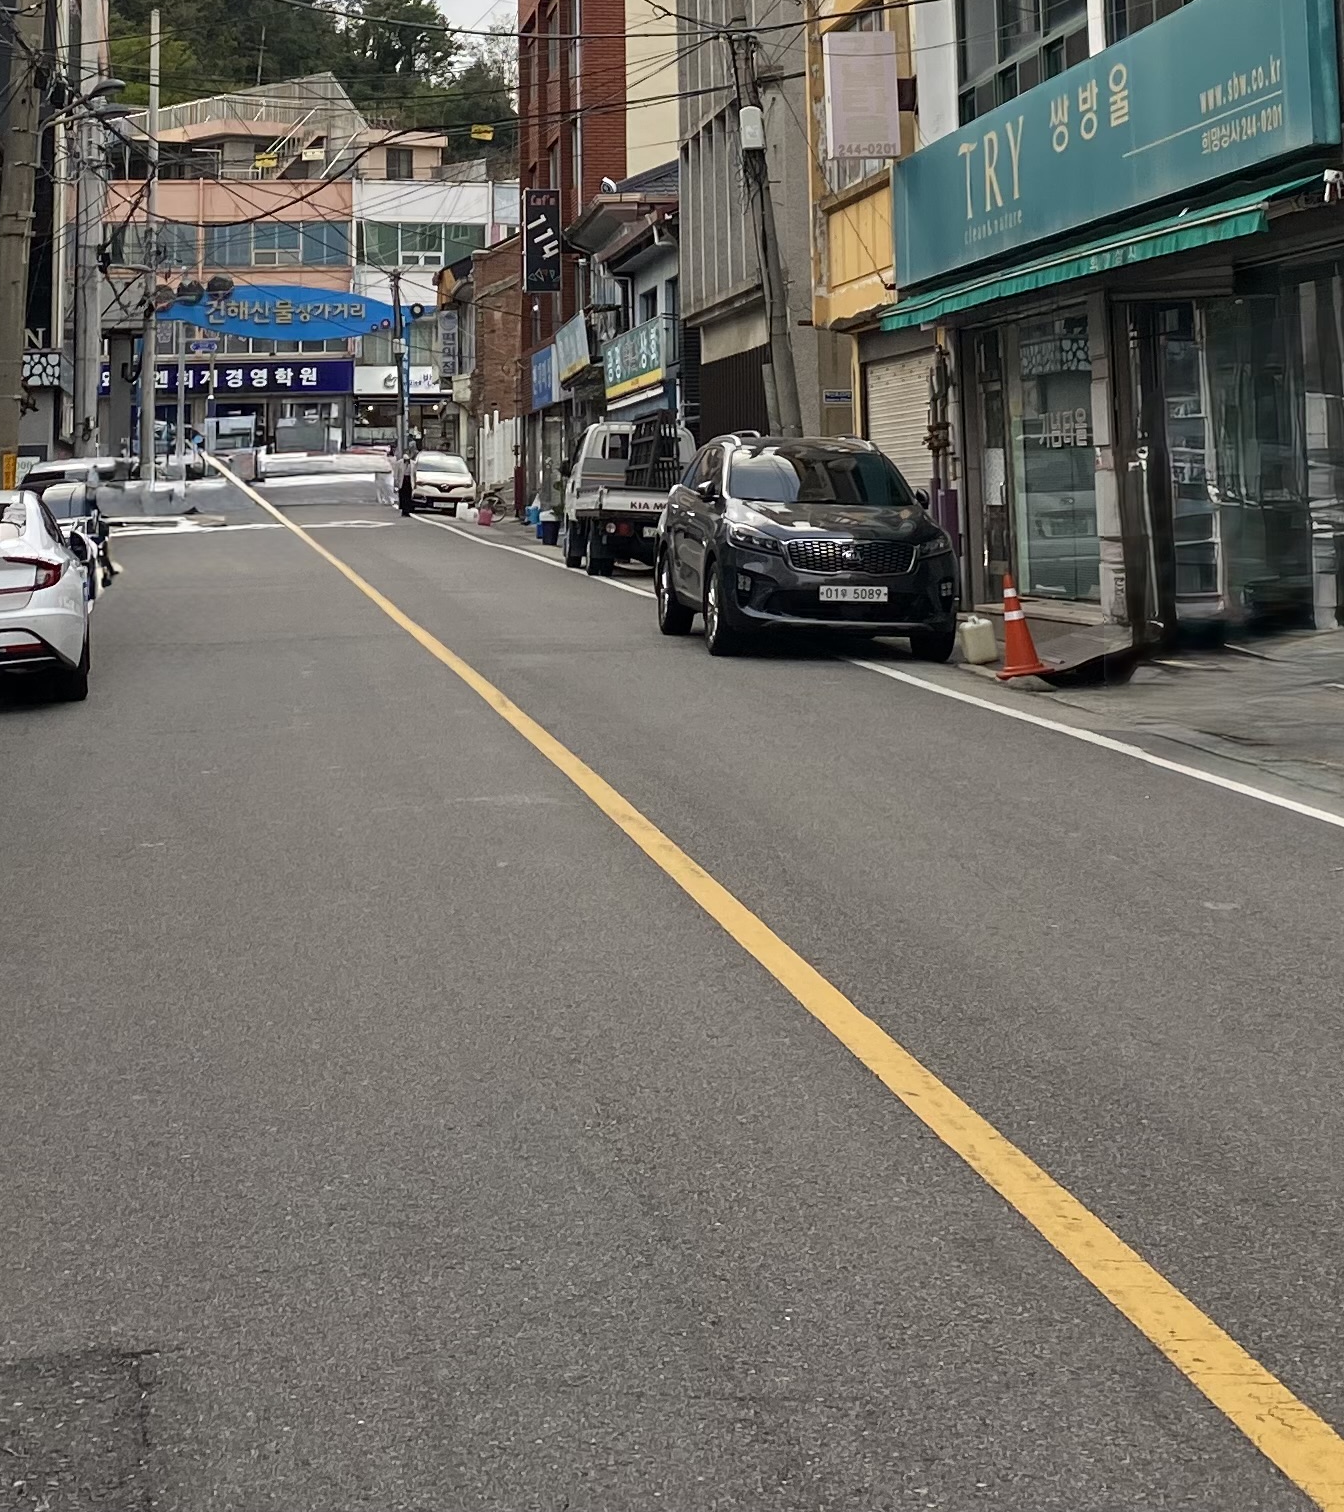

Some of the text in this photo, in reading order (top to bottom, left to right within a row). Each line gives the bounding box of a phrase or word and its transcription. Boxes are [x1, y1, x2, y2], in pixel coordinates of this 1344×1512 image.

[1199, 53, 1281, 115] www.sbw.co.kr
[1048, 62, 1130, 154] 쌍방울
[838, 143, 897, 157] 244-0201
[957, 115, 1026, 220] TRY
[630, 500, 650, 510] KIA
[853, 588, 882, 600] 5089
